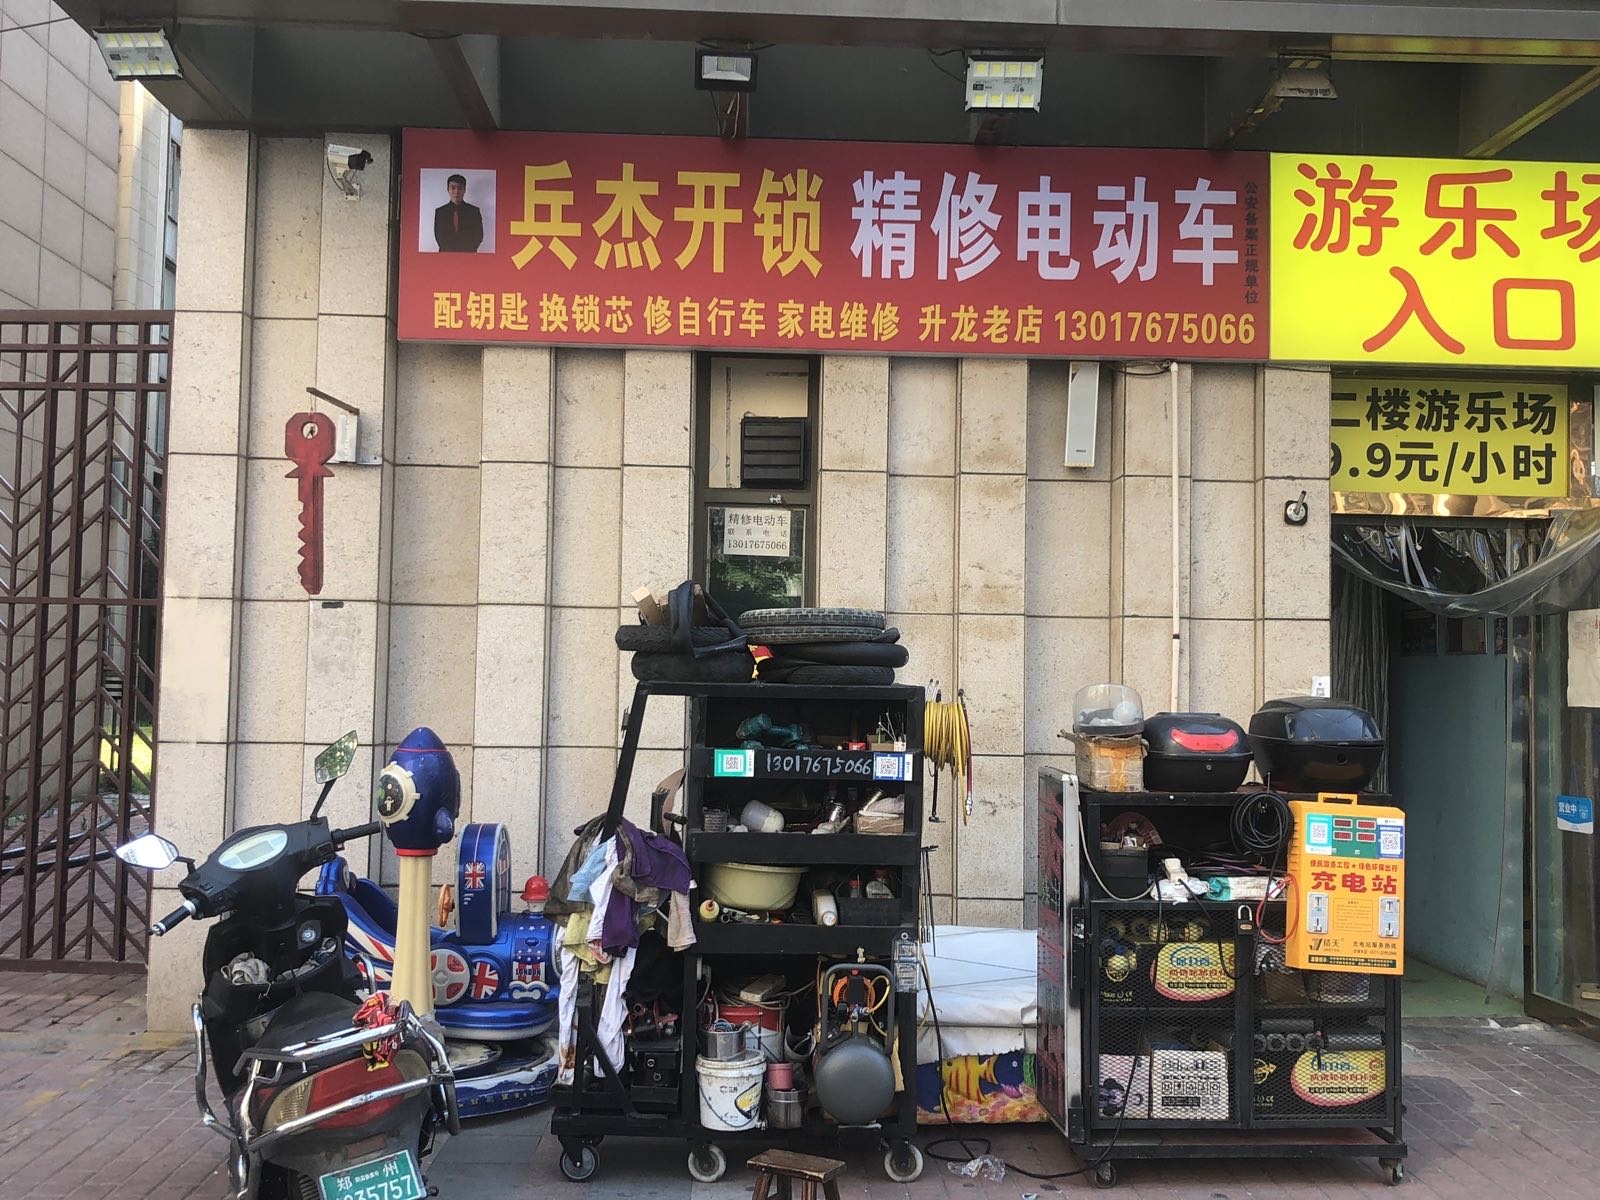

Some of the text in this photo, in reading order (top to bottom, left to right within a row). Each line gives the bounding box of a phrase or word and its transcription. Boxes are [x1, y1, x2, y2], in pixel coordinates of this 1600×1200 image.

[510, 160, 1239, 286] 兵杰开锁 精修电动车
[1293, 162, 1600, 263] 游乐场
[1244, 181, 1260, 304] 公安备案正规单位
[433, 291, 1256, 344] 配钥匙 换锁芯 修自行车 家电维修 升龙老店 13017675066
[1362, 266, 1577, 355] 入口
[1331, 387, 1557, 435] 二楼游乐场
[728, 513, 788, 527] 精修电动车
[727, 540, 787, 551] 13017675066
[766, 752, 872, 776] 13017675066
[1311, 871, 1397, 894] 充电站
[516, 968, 541, 976] LONDON
[336, 1175, 352, 1192] 郑
[383, 1160, 399, 1177] 州
